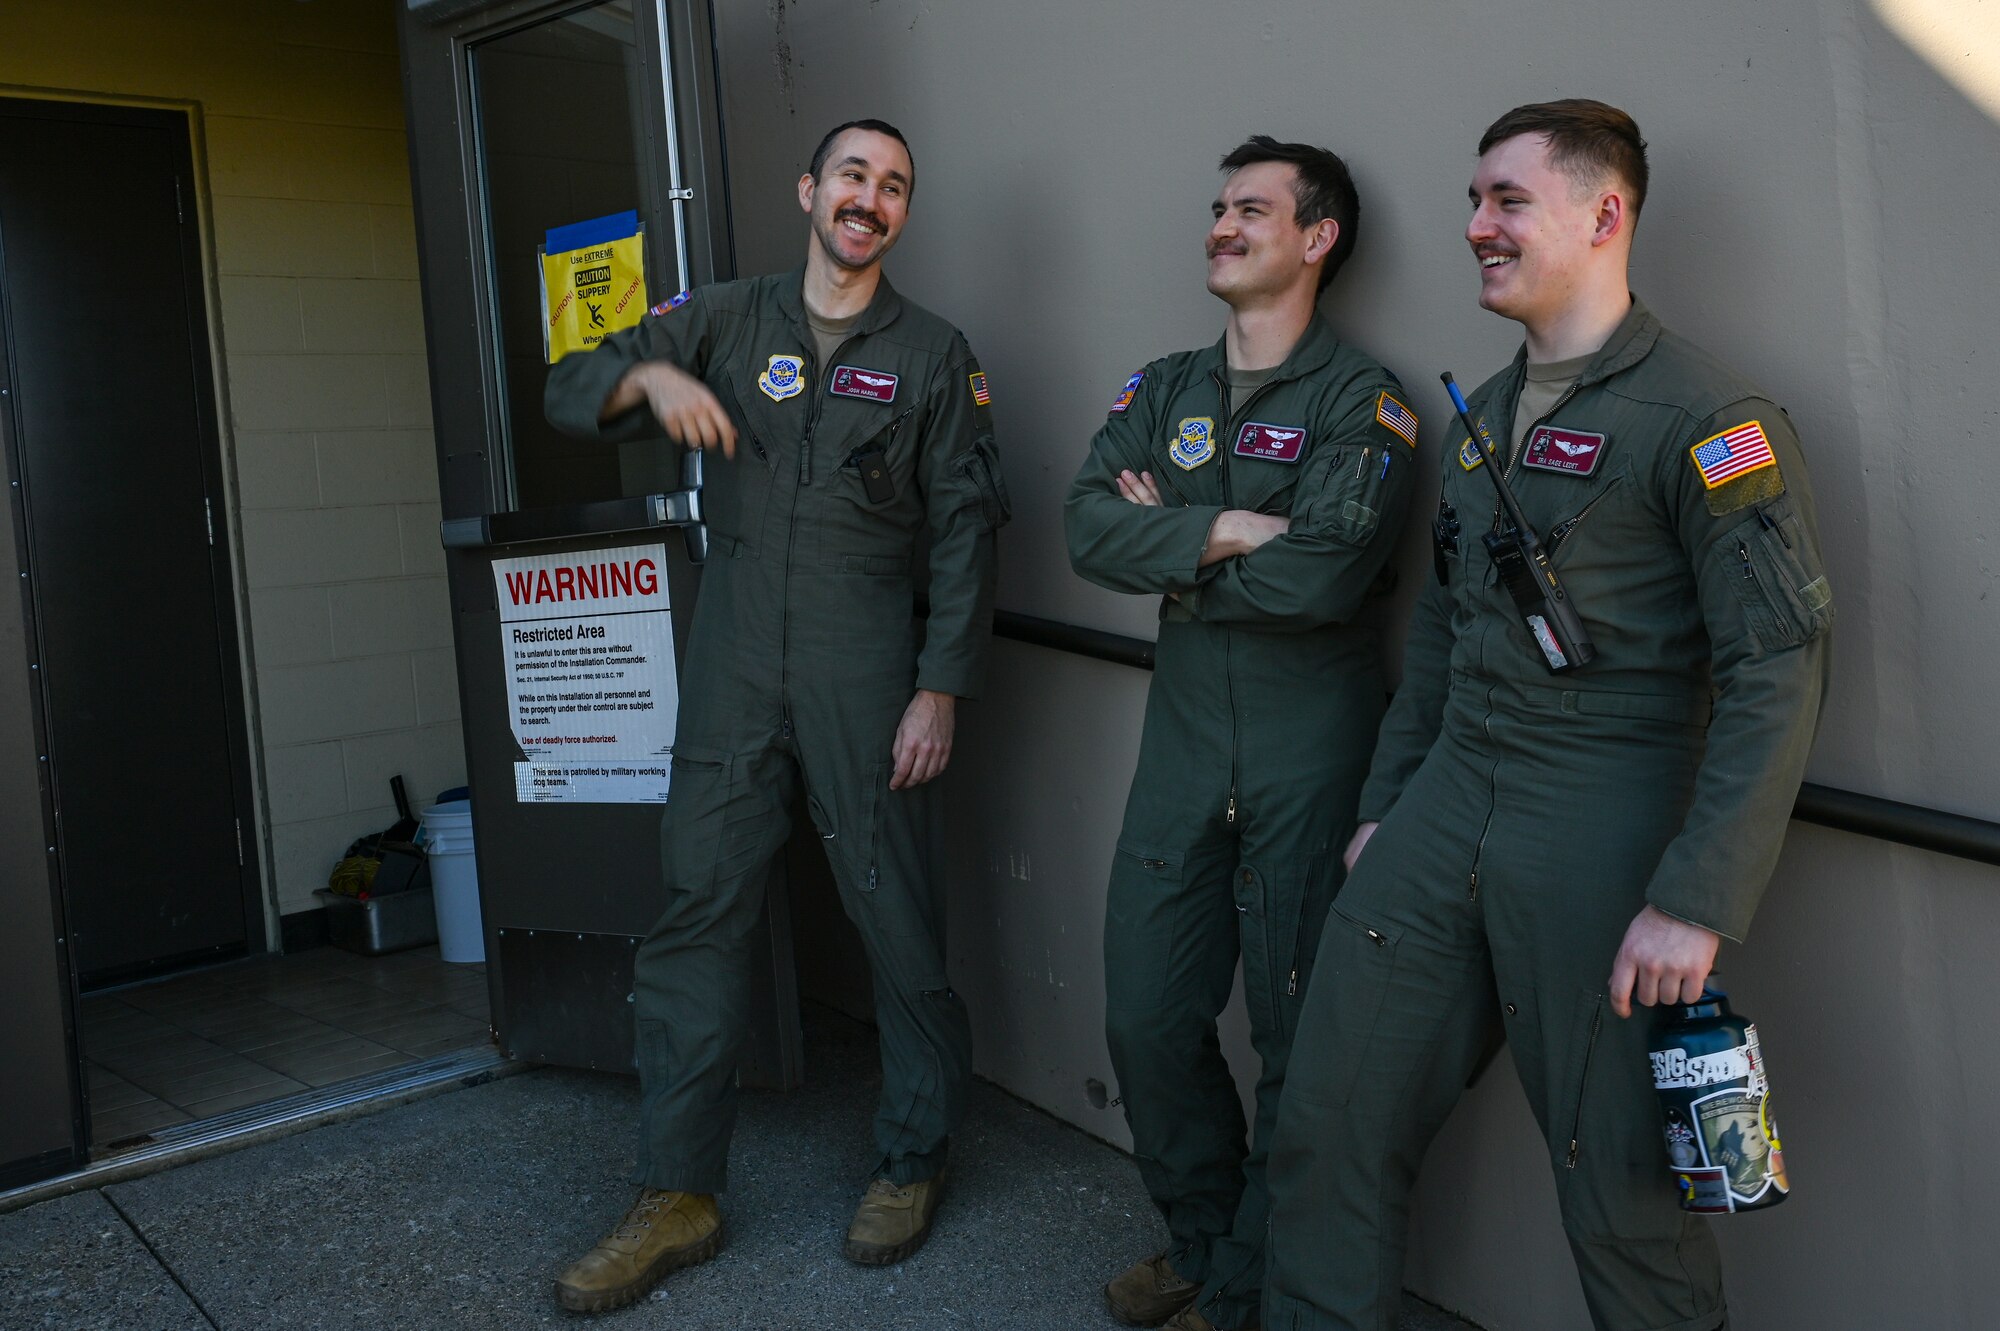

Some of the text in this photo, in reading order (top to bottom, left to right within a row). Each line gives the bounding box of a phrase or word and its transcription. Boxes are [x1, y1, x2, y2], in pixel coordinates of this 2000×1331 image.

[571, 248, 613, 264] Use EXTREME
[576, 268, 610, 284] CAUTION
[578, 285, 610, 299] SLIPPERY
[615, 276, 641, 314] CAUTION!
[550, 290, 574, 327] CAUTION!
[583, 334, 602, 345] When
[505, 558, 657, 606] WARNING
[513, 624, 605, 643] Restricted Area
[527, 649, 552, 657] unlawful
[562, 648, 578, 656] enter
[580, 647, 591, 655] this
[608, 645, 632, 653] without
[516, 660, 549, 671] permission
[551, 660, 557, 668] of
[570, 658, 604, 667] Installation
[606, 656, 647, 665] Commander.
[519, 694, 535, 702] While
[546, 693, 557, 701] this
[559, 691, 593, 700] Installation
[604, 690, 636, 700] personnel
[638, 689, 650, 697] and
[520, 706, 529, 714] the
[531, 704, 557, 714] property
[558, 704, 575, 713] under
[577, 703, 591, 712] their
[594, 702, 616, 711] control
[629, 701, 653, 711] subject
[521, 717, 527, 725] to
[522, 737, 534, 745] Use
[543, 736, 563, 745] deadly
[565, 736, 580, 744] force
[582, 735, 618, 743] authorized.
[533, 768, 546, 776] This
[563, 768, 569, 776] is
[571, 768, 599, 777] patrolled
[601, 768, 610, 777] by
[611, 767, 636, 777] military
[639, 767, 666, 777] working
[534, 778, 568, 787] dog teams.
